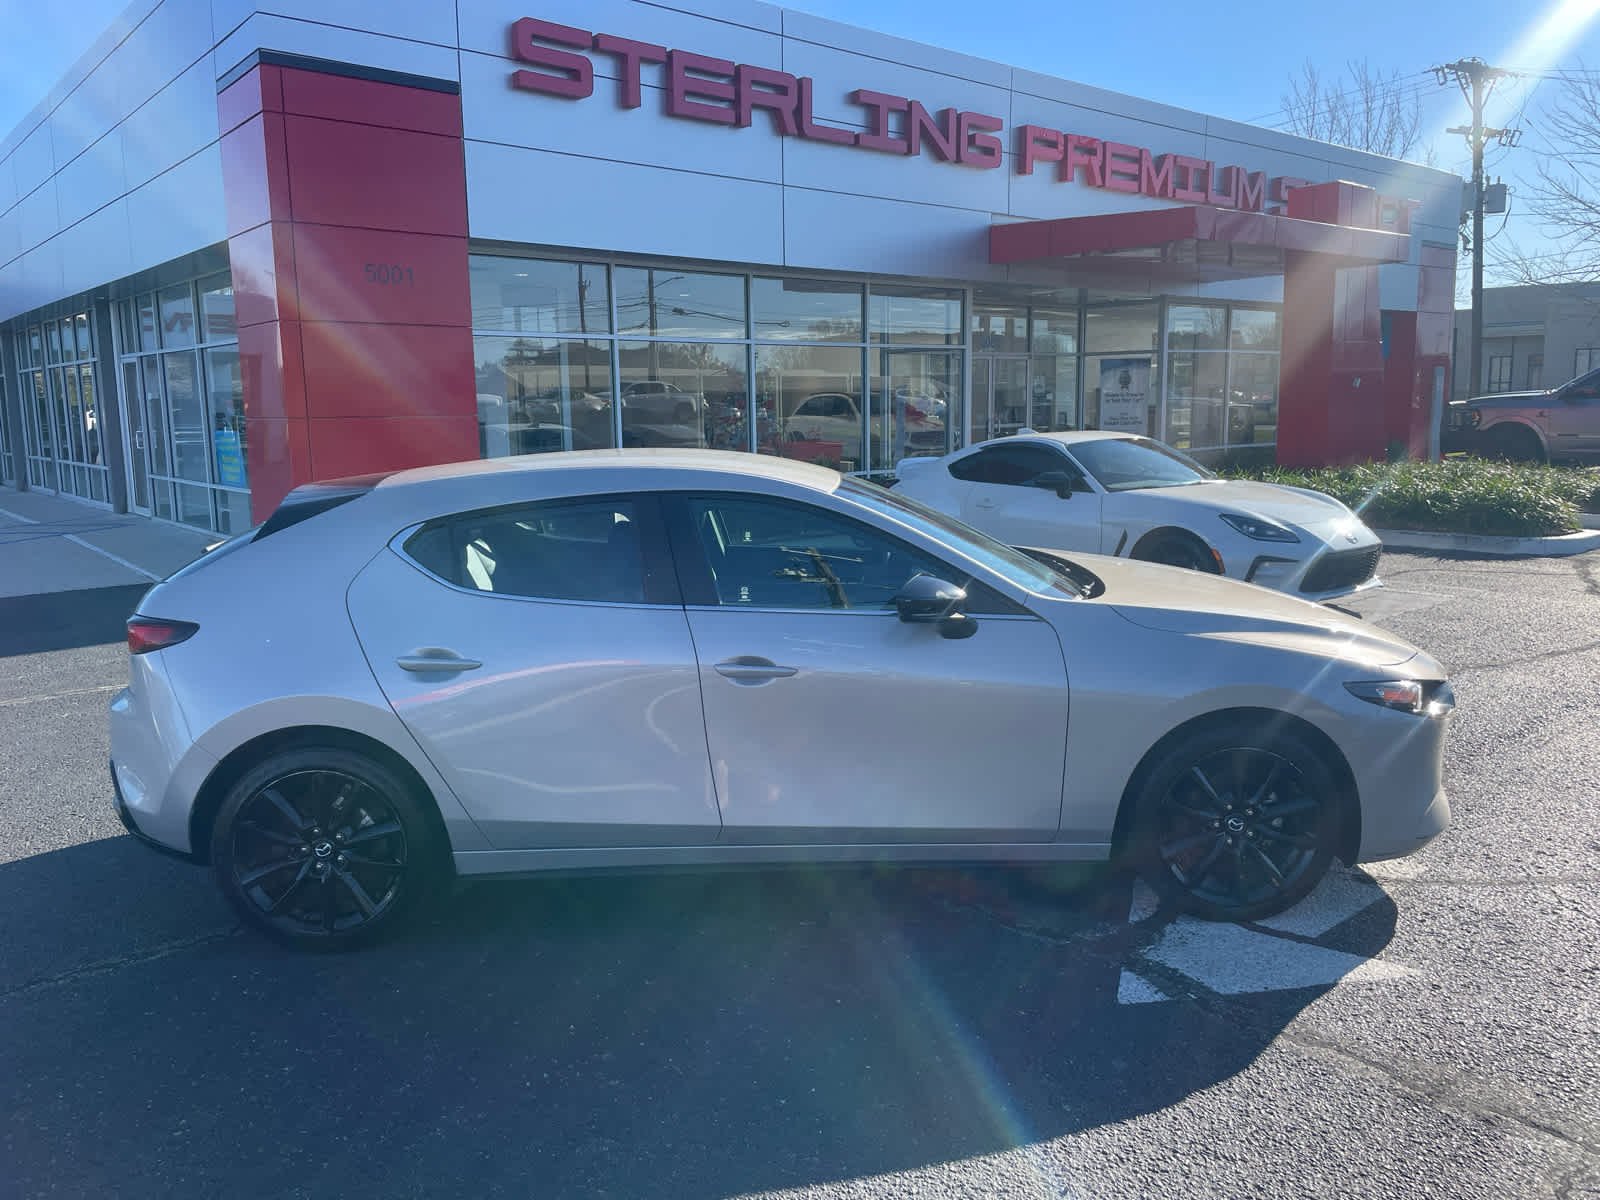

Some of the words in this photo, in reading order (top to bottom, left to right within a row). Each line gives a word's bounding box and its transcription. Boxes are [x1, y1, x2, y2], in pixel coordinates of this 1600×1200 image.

[511, 16, 1004, 169] STERLING
[1016, 124, 1267, 211] PREMIUM
[364, 263, 416, 286] 5001
